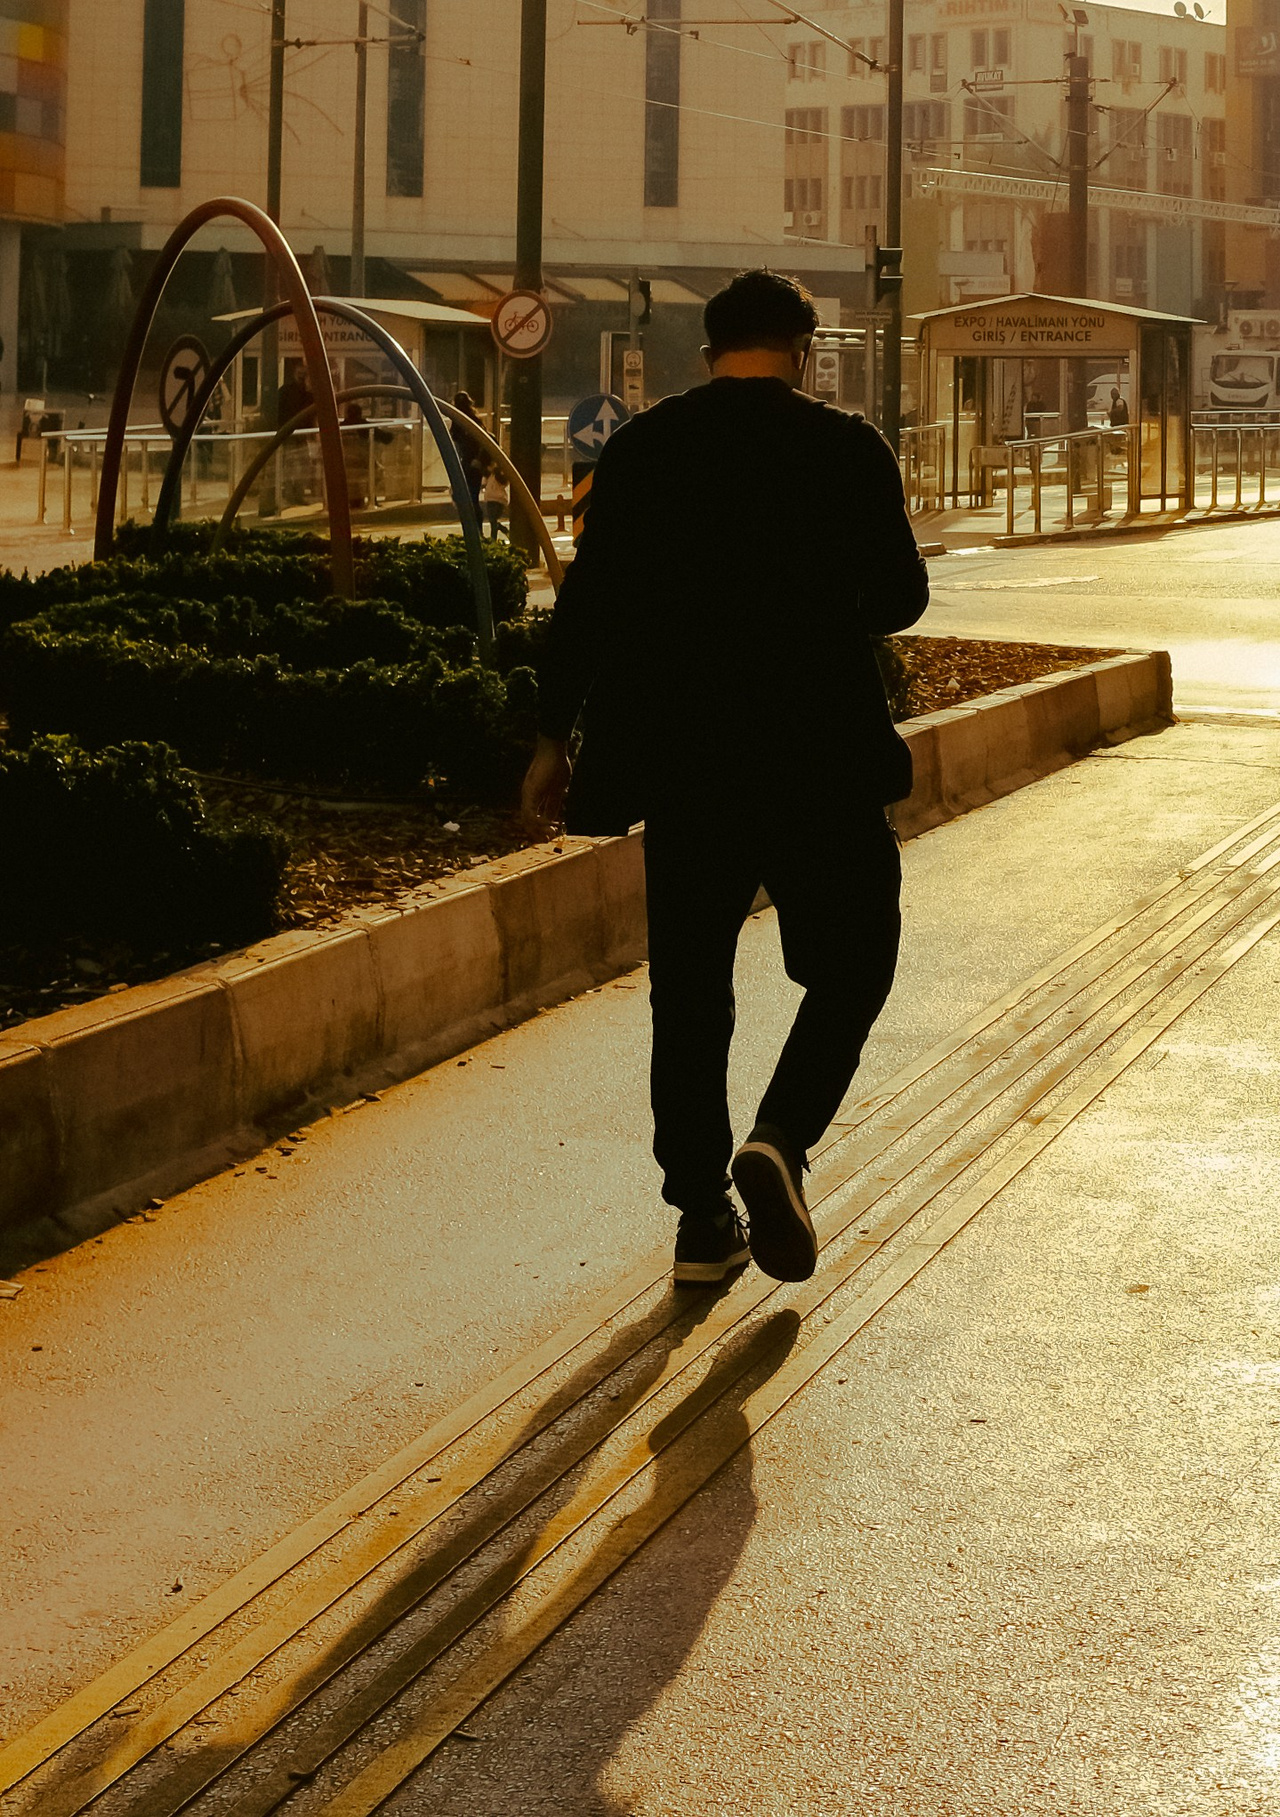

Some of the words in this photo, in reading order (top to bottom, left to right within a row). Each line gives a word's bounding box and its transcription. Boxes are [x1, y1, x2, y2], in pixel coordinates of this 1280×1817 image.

[954, 315, 986, 328] EXPO
[996, 314, 1068, 328] HAVALİMANI
[1072, 314, 1105, 328] YÖNÜ
[972, 328, 1006, 344] GİRİŞ
[1020, 330, 1092, 342] ENTRANCE
